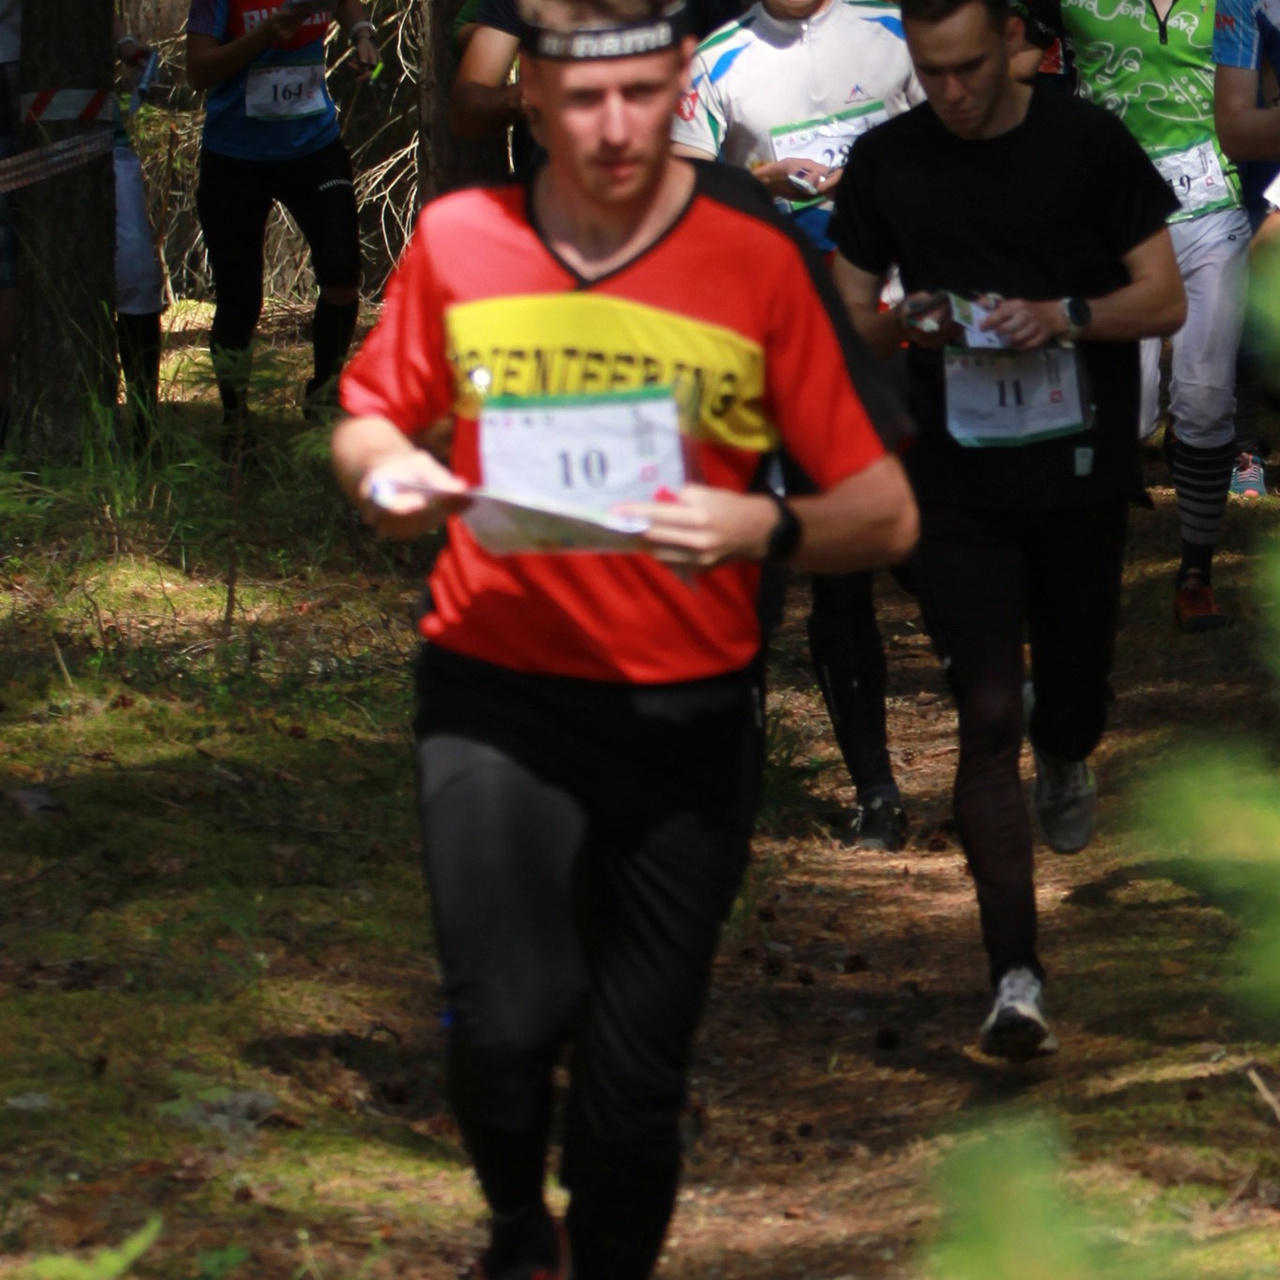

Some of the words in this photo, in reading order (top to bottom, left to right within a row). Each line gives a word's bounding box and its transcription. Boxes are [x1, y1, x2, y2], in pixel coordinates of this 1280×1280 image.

[271, 83, 303, 101] 164
[997, 380, 1024, 407] 11
[558, 450, 608, 487] 10
